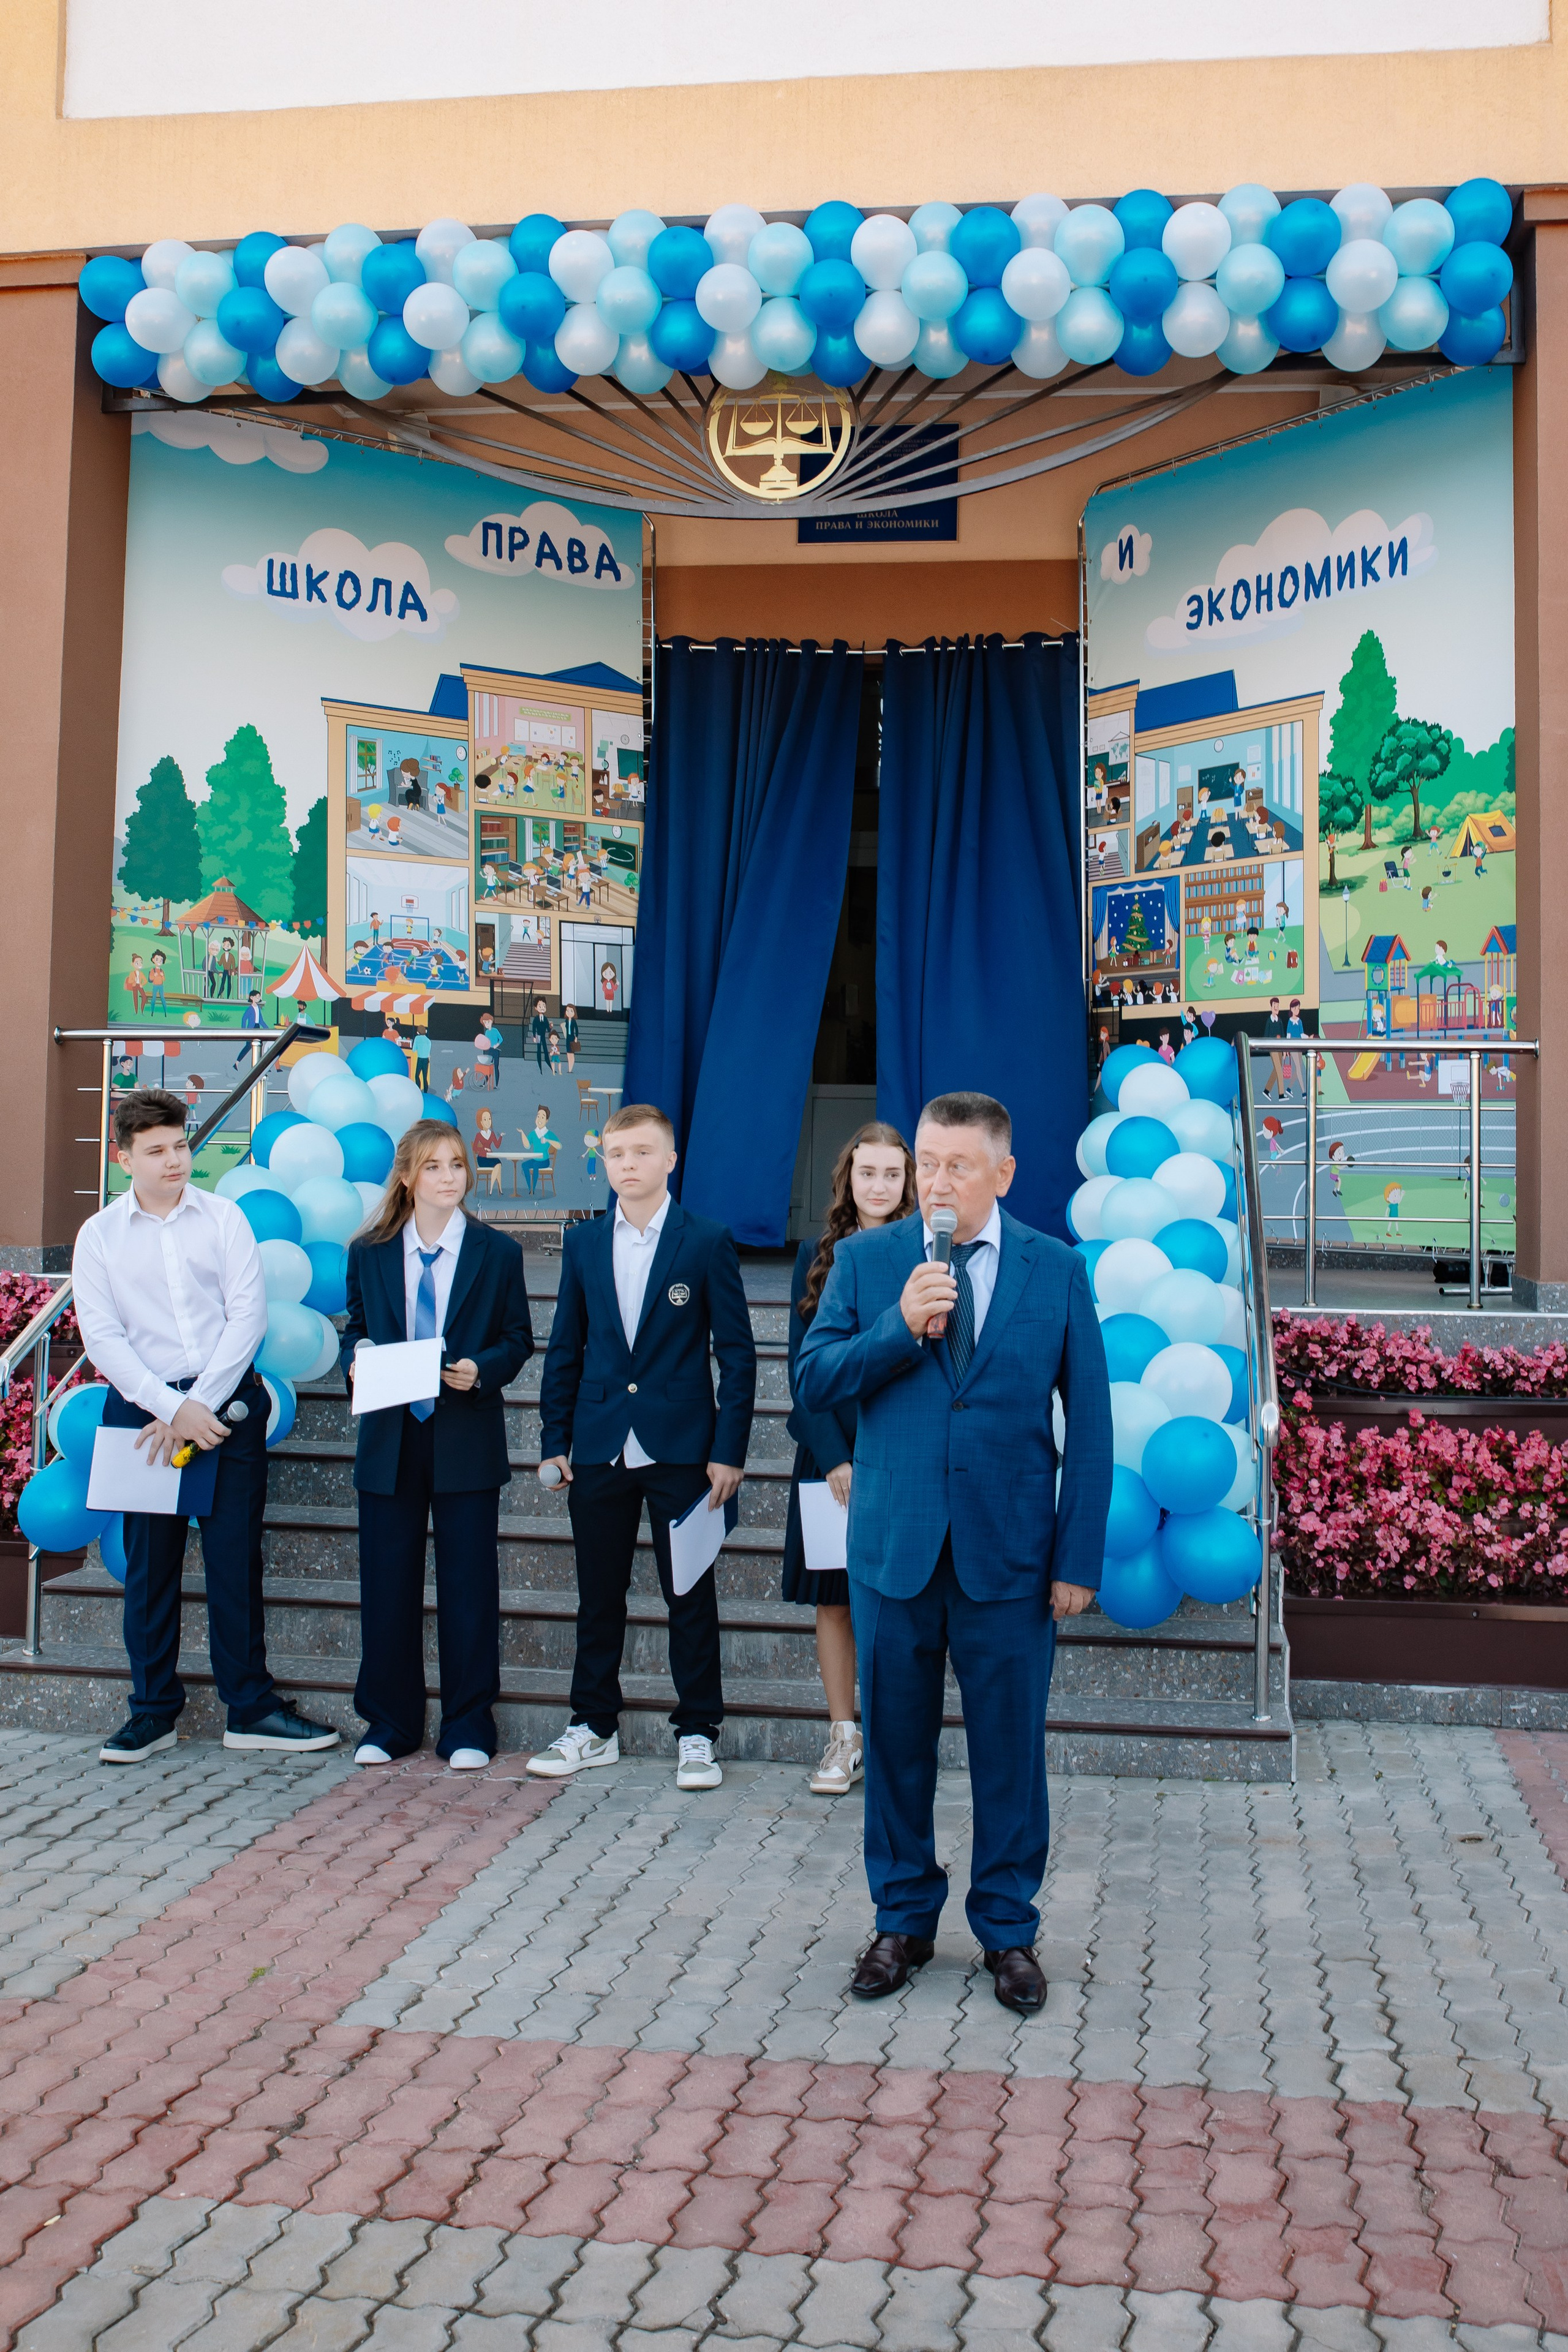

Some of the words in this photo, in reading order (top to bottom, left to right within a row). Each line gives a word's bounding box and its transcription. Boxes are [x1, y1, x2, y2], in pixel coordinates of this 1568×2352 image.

[266, 558, 428, 622] ШКОЛА
[482, 521, 622, 582] ПРАВА
[816, 521, 851, 530] ПРАВА
[867, 519, 939, 529] ЭКОНОМИКИ
[1118, 534, 1134, 571] И
[1186, 536, 1408, 630] ЭКОНОМИКИ
